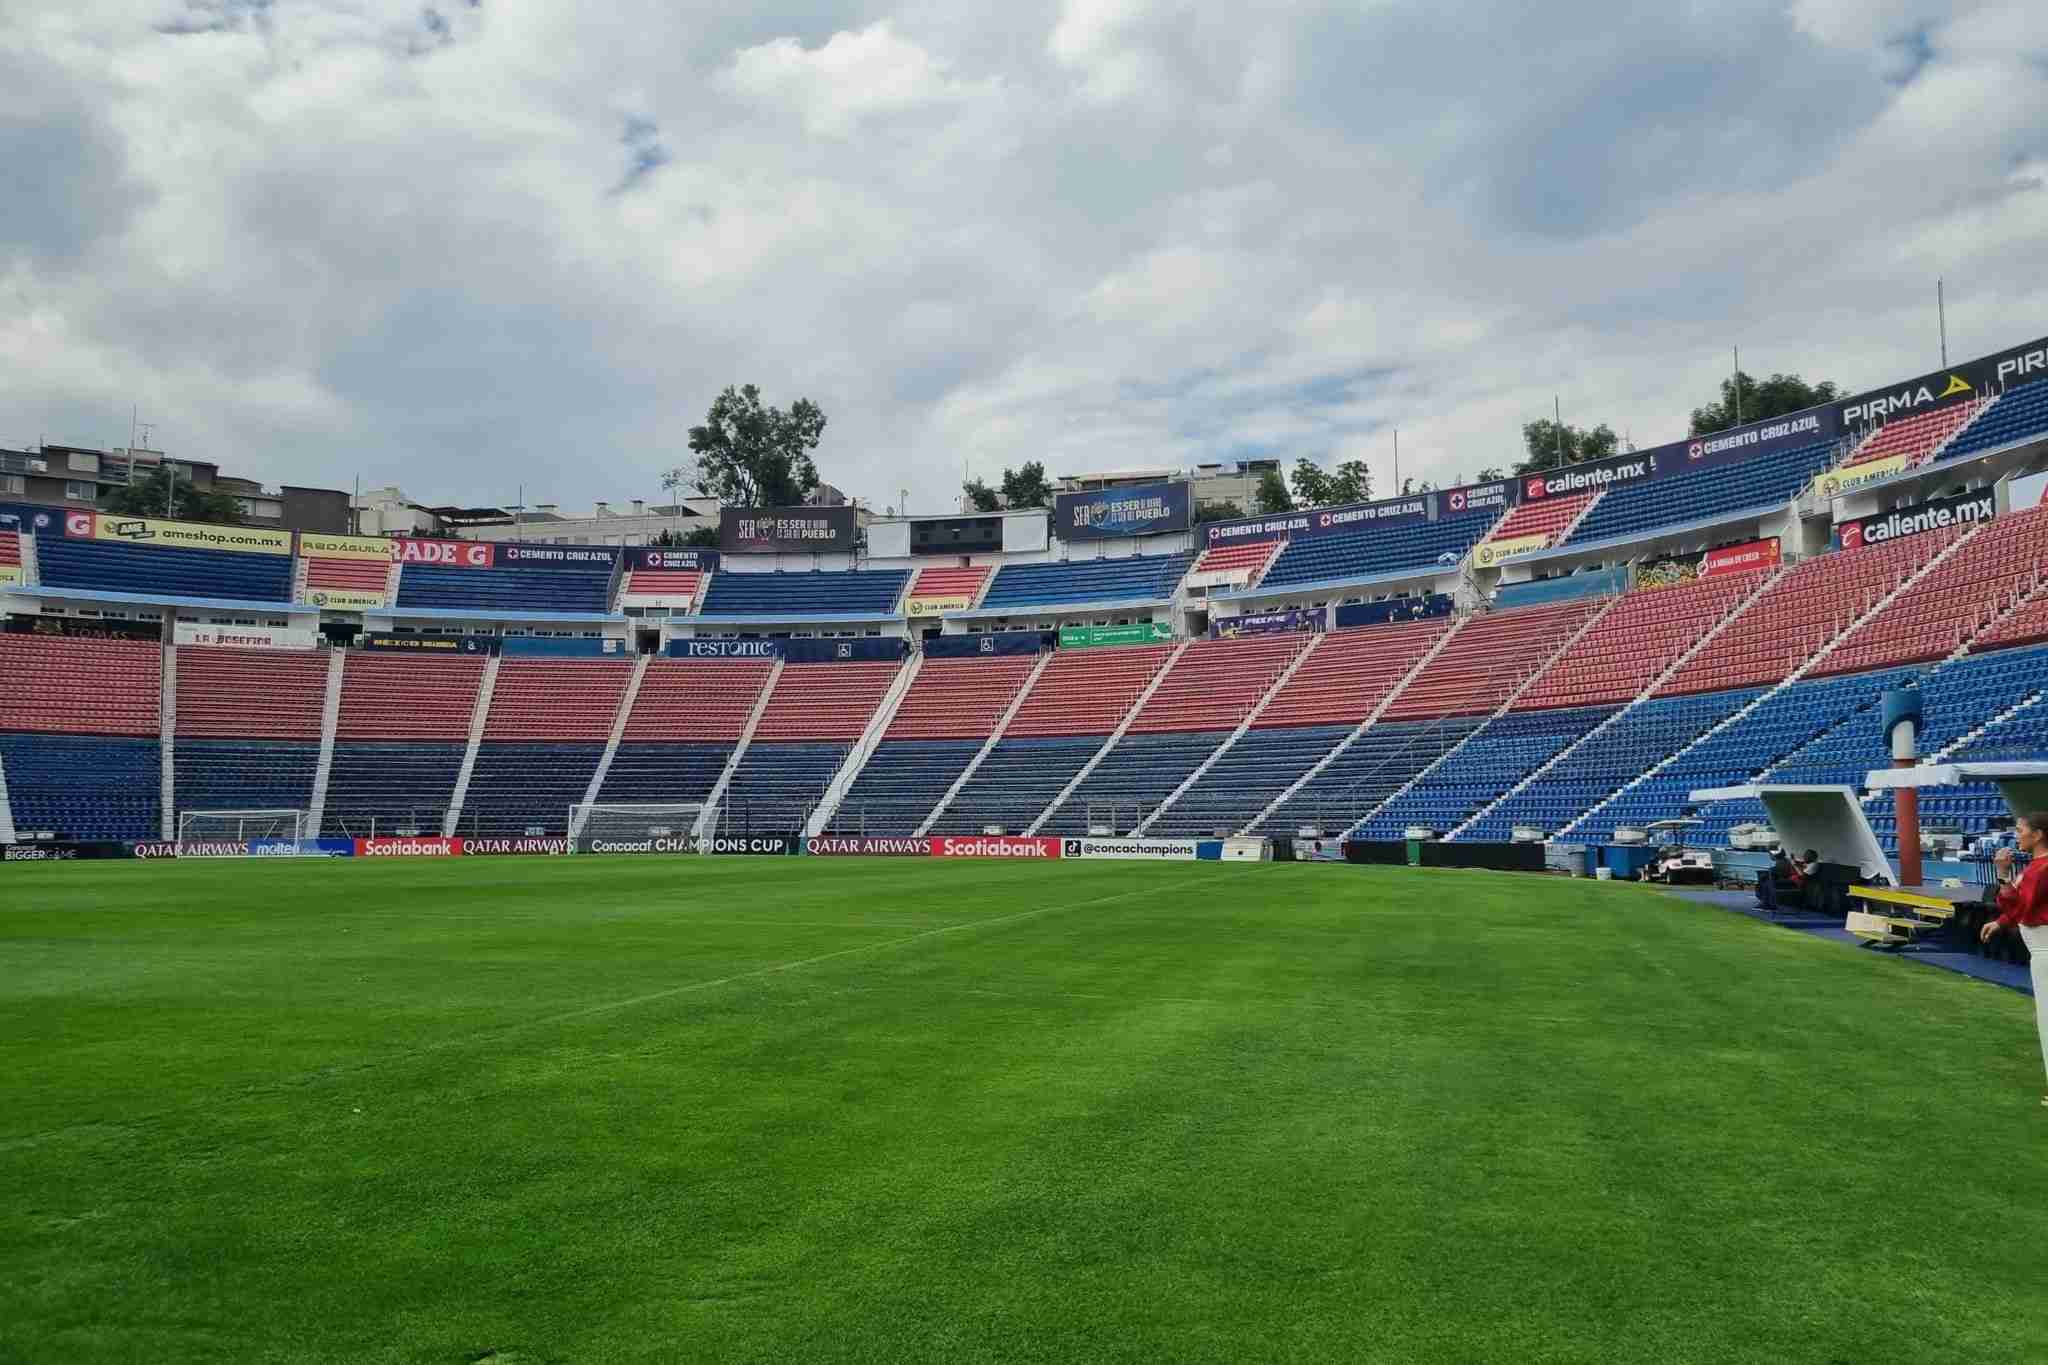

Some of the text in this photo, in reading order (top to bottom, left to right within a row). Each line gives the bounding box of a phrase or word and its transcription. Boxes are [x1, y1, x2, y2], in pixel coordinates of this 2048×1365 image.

[1997, 349, 2048, 381] PIR
[1843, 386, 1935, 425] PIRMA
[1704, 415, 1819, 453] CEMENTO CRUZ AZUL
[1545, 461, 1645, 494] caliente.mx
[1136, 507, 1170, 520] PUEBLO
[1332, 502, 1424, 525] CEMENTO CRUZ AZUL
[1863, 497, 1993, 542] caliente.mx
[801, 529, 836, 538] PUEBLO
[1221, 517, 1310, 537] CEMENTO CRUZ AZUL
[163, 530, 282, 547] ameshop.com.mx
[467, 546, 486, 564] G
[520, 551, 613, 561] CEMENTO CRUZ AZUL
[663, 552, 698, 560] CEMENTO
[134, 842, 248, 857] QATAR AIRWAYS
[365, 840, 450, 856] Scotiabank
[463, 840, 574, 855] QATAR AIRWAYS
[592, 838, 783, 852] Concacaf CHAMPIONS CUP
[807, 838, 930, 853] QATAR AIRWAYS
[944, 838, 1046, 857] Scotiabank
[1084, 842, 1193, 857] @concachampions
